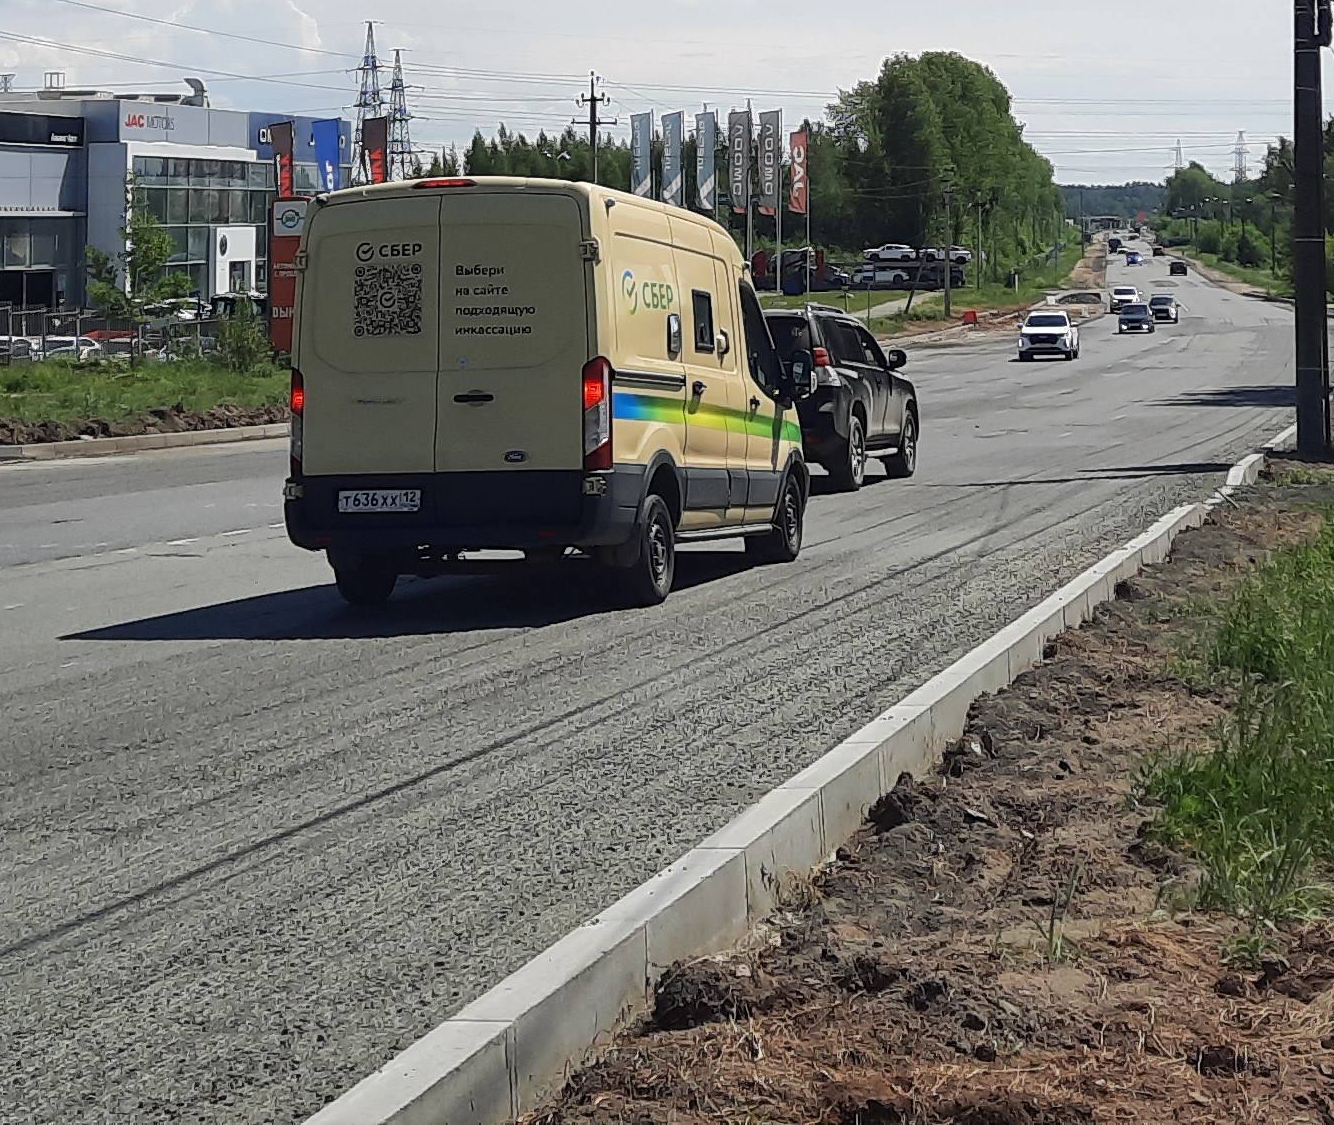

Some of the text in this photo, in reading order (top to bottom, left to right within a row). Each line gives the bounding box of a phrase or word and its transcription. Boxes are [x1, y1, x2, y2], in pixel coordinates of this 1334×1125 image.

[125, 114, 145, 128] JAC
[378, 243, 423, 258] СБЕР
[455, 265, 505, 277] Выбери
[455, 284, 509, 296] на сайте
[642, 282, 673, 310] СБЕР
[455, 305, 536, 318] подходящую
[455, 325, 532, 337] инкассацию
